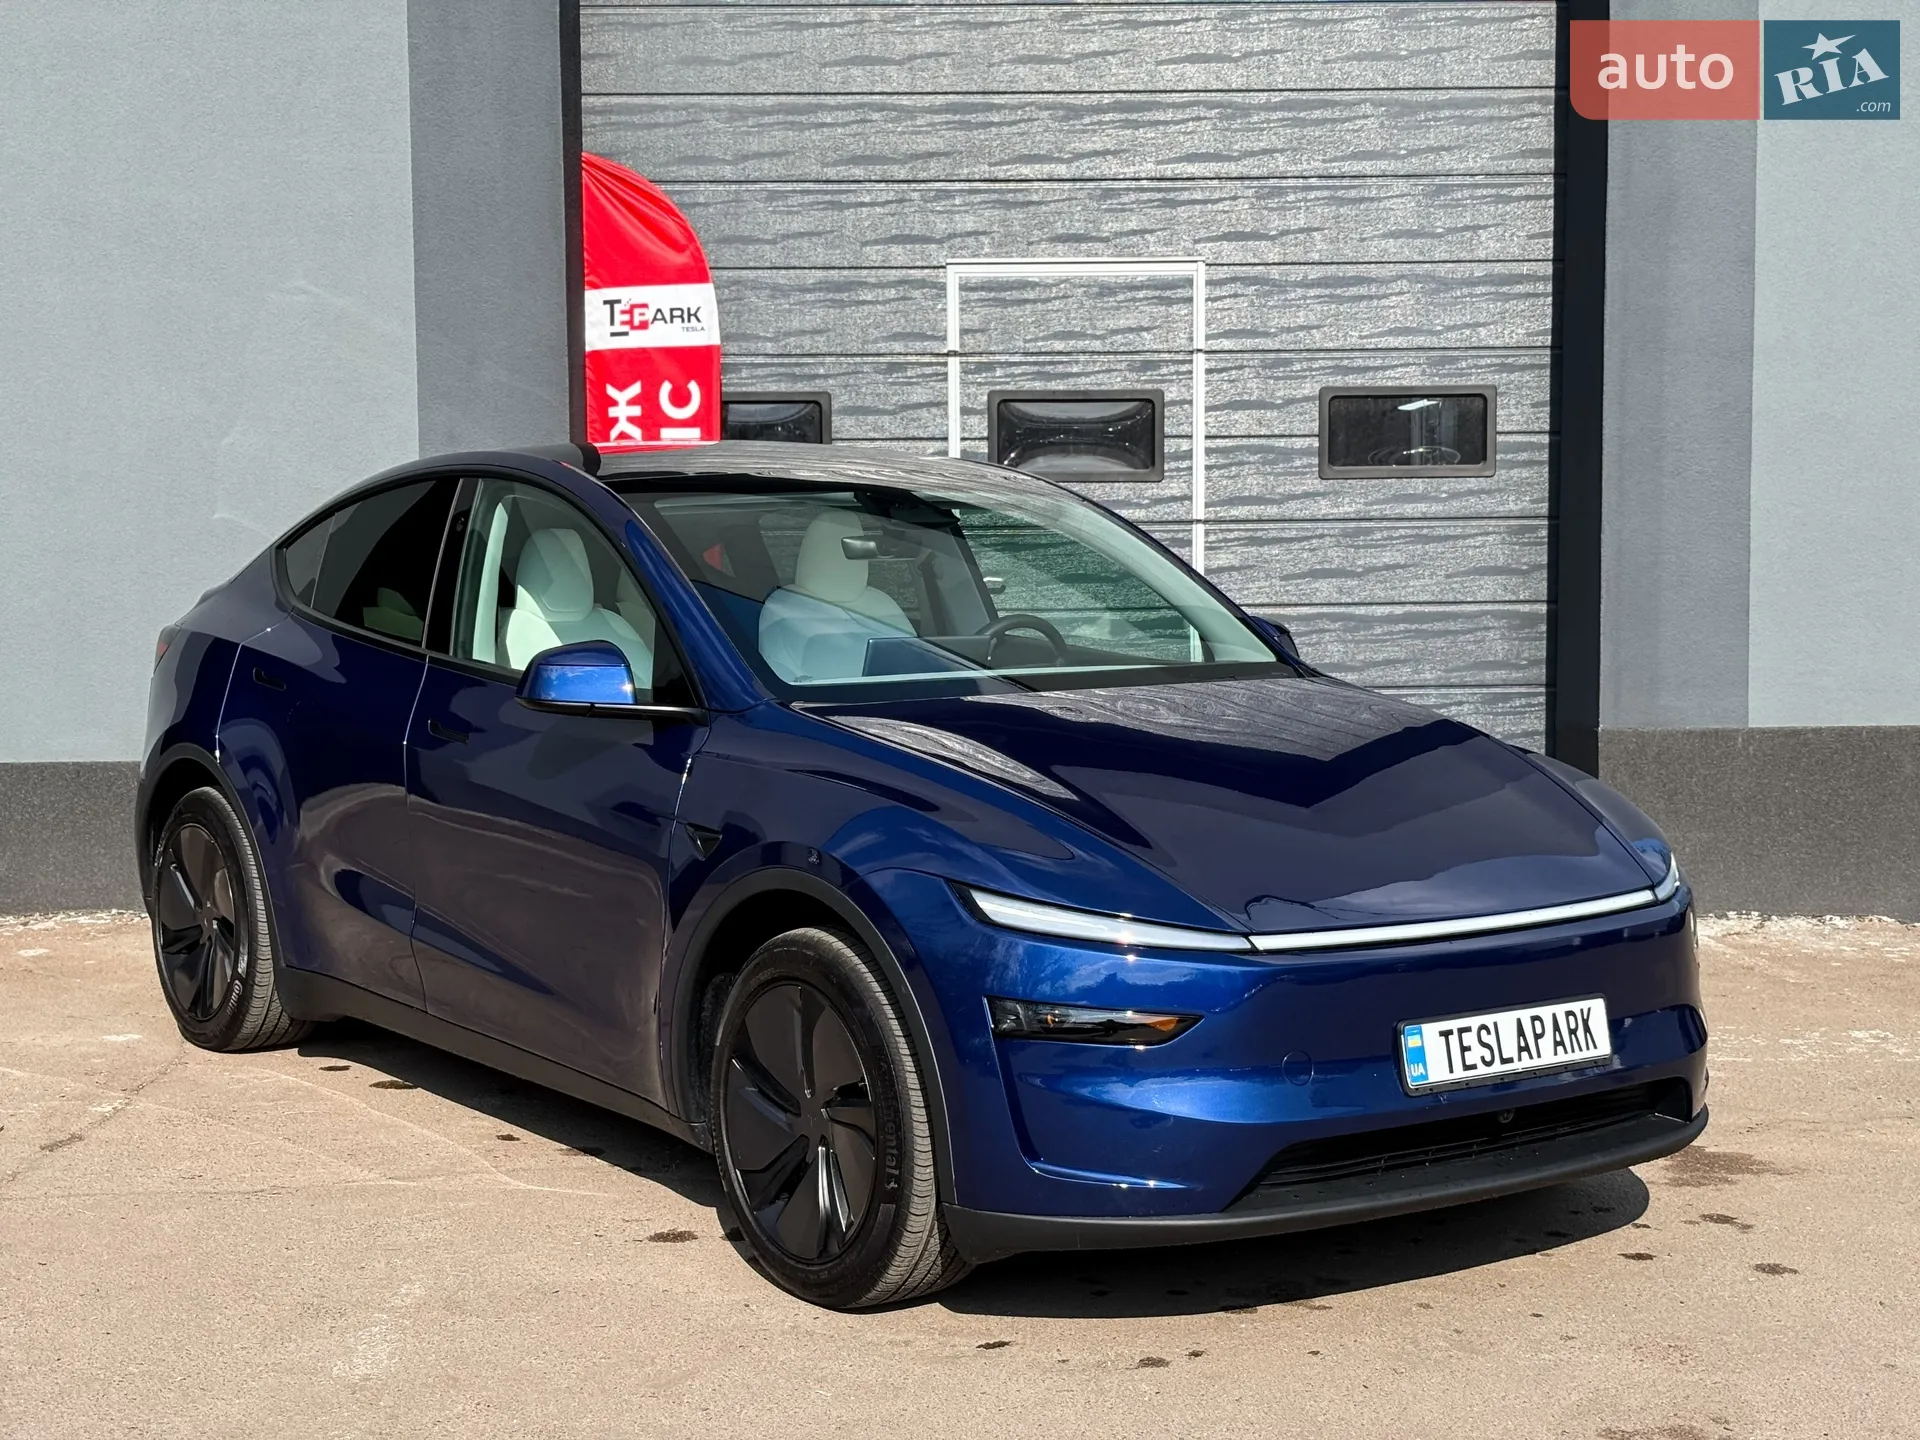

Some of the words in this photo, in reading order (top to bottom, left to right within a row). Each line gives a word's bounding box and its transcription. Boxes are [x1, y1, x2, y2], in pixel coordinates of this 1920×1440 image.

[680, 325, 706, 333] TESLA
[1438, 1006, 1598, 1074] TESLAPARK
[1410, 1063, 1426, 1077] UA
